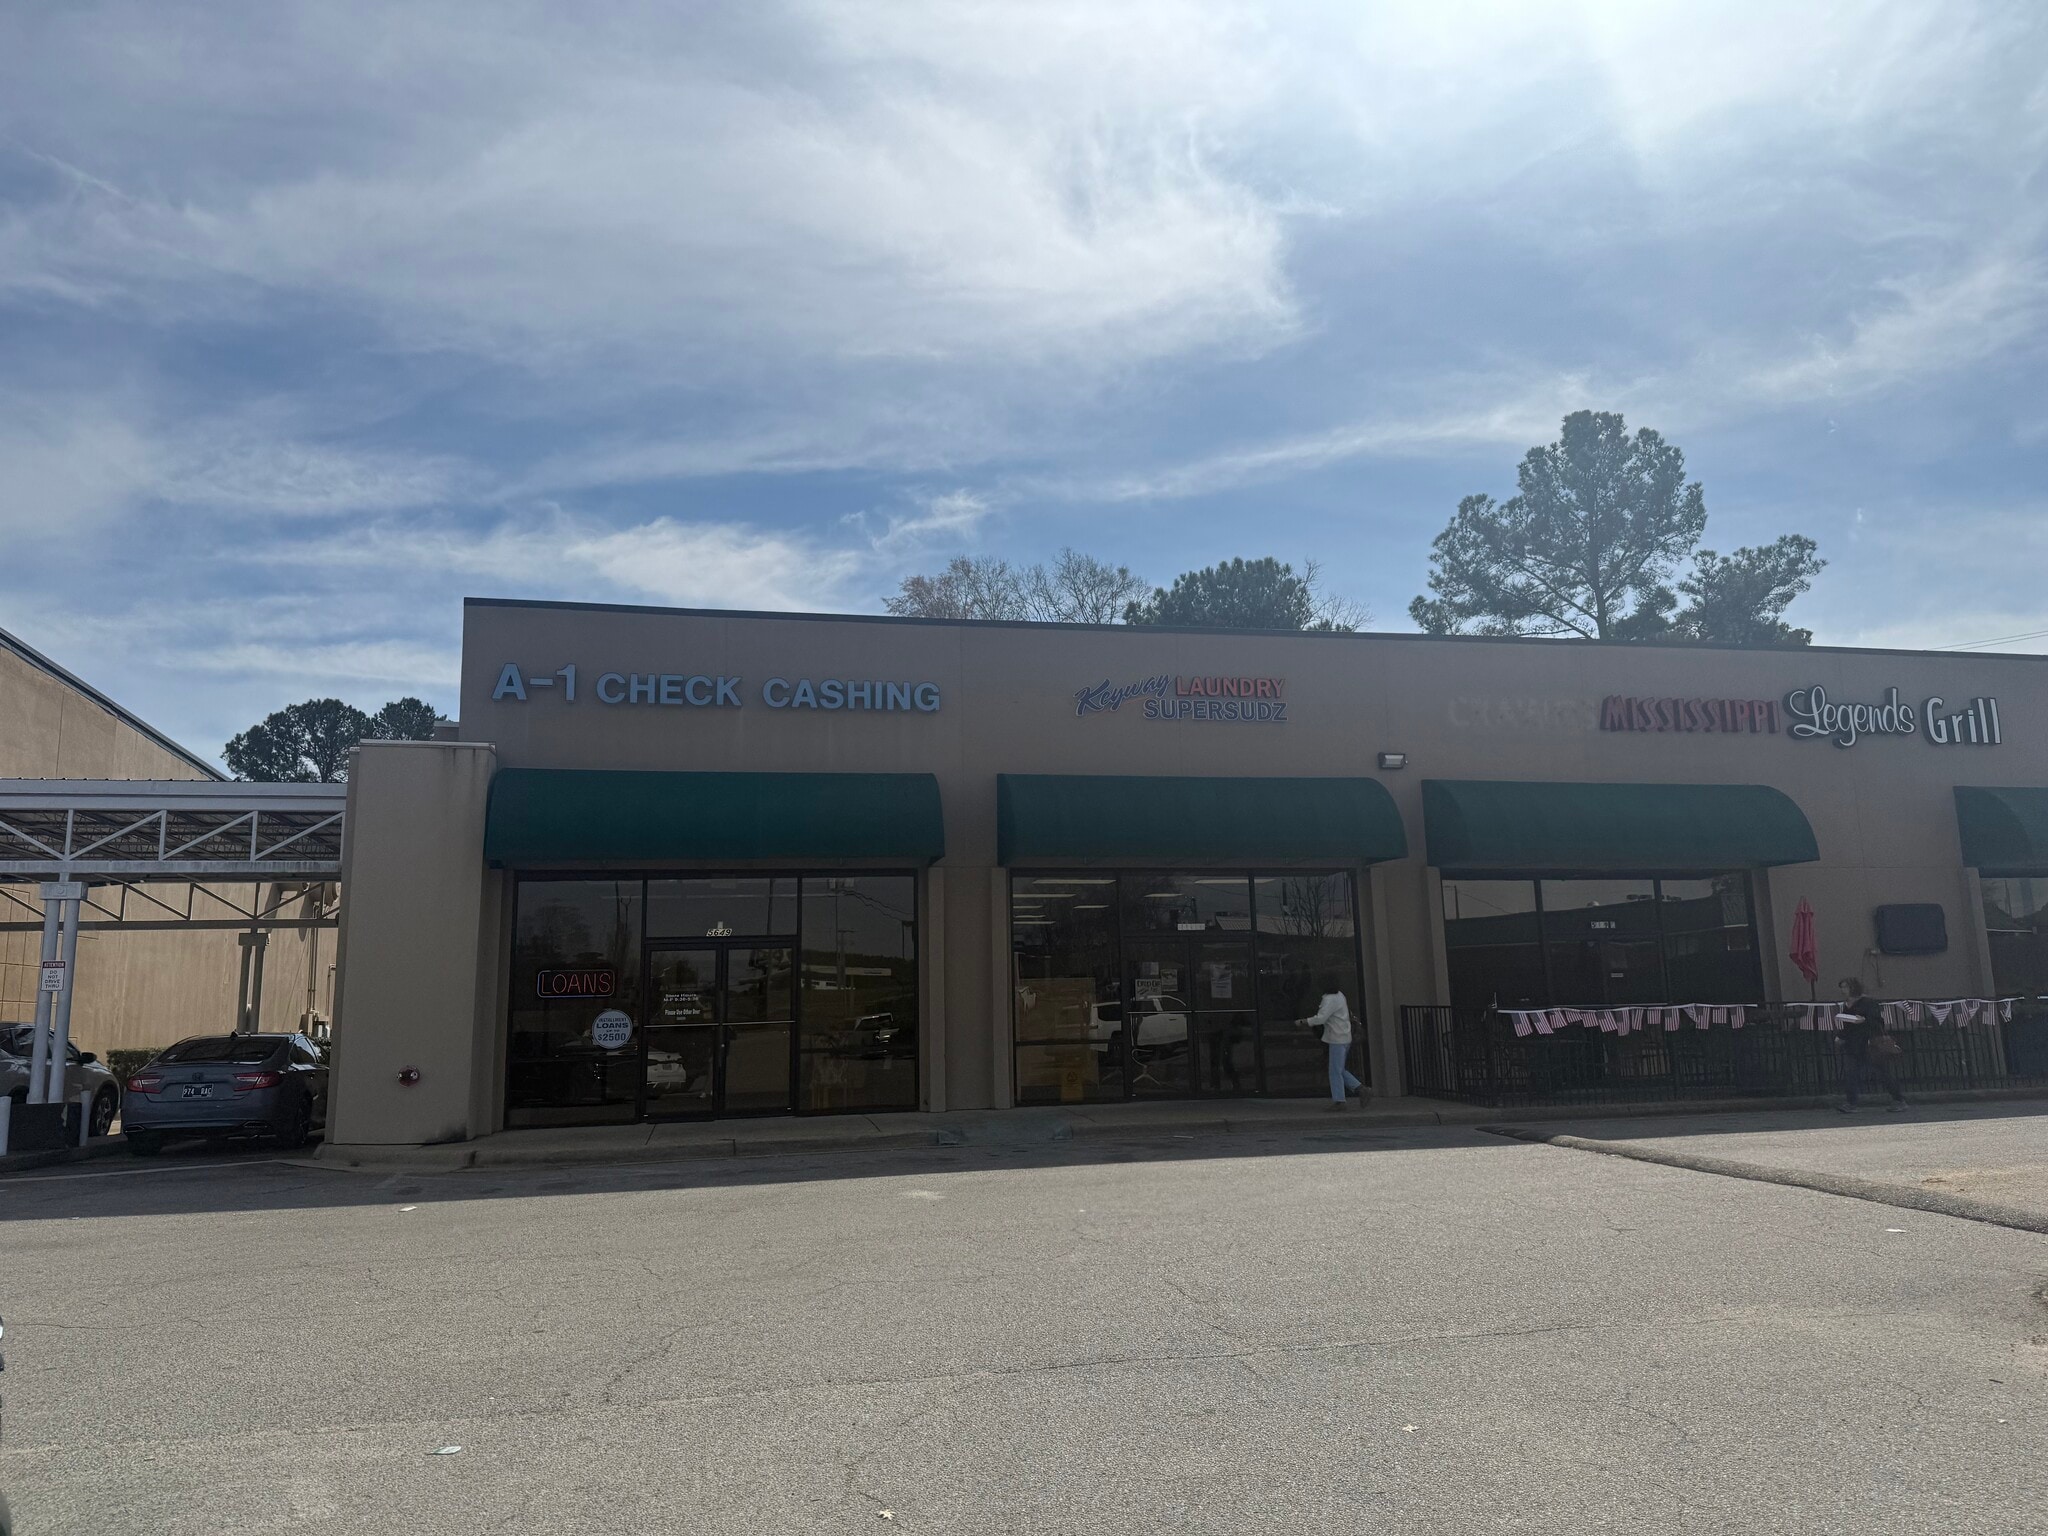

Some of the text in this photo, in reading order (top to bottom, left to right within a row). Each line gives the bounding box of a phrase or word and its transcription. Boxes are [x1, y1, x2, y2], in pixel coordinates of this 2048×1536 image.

[491, 661, 942, 712] A-1 CHECK CASHING
[1073, 674, 1285, 717] Keyway LAUNDRY
[1143, 699, 1289, 722] SUPERSUDZ
[1601, 694, 1780, 733] MISSISSIPPI
[1785, 685, 1915, 748] Legends
[1922, 697, 2001, 745] Grill
[541, 972, 612, 994] LOANS
[597, 1033, 626, 1041] $2500
